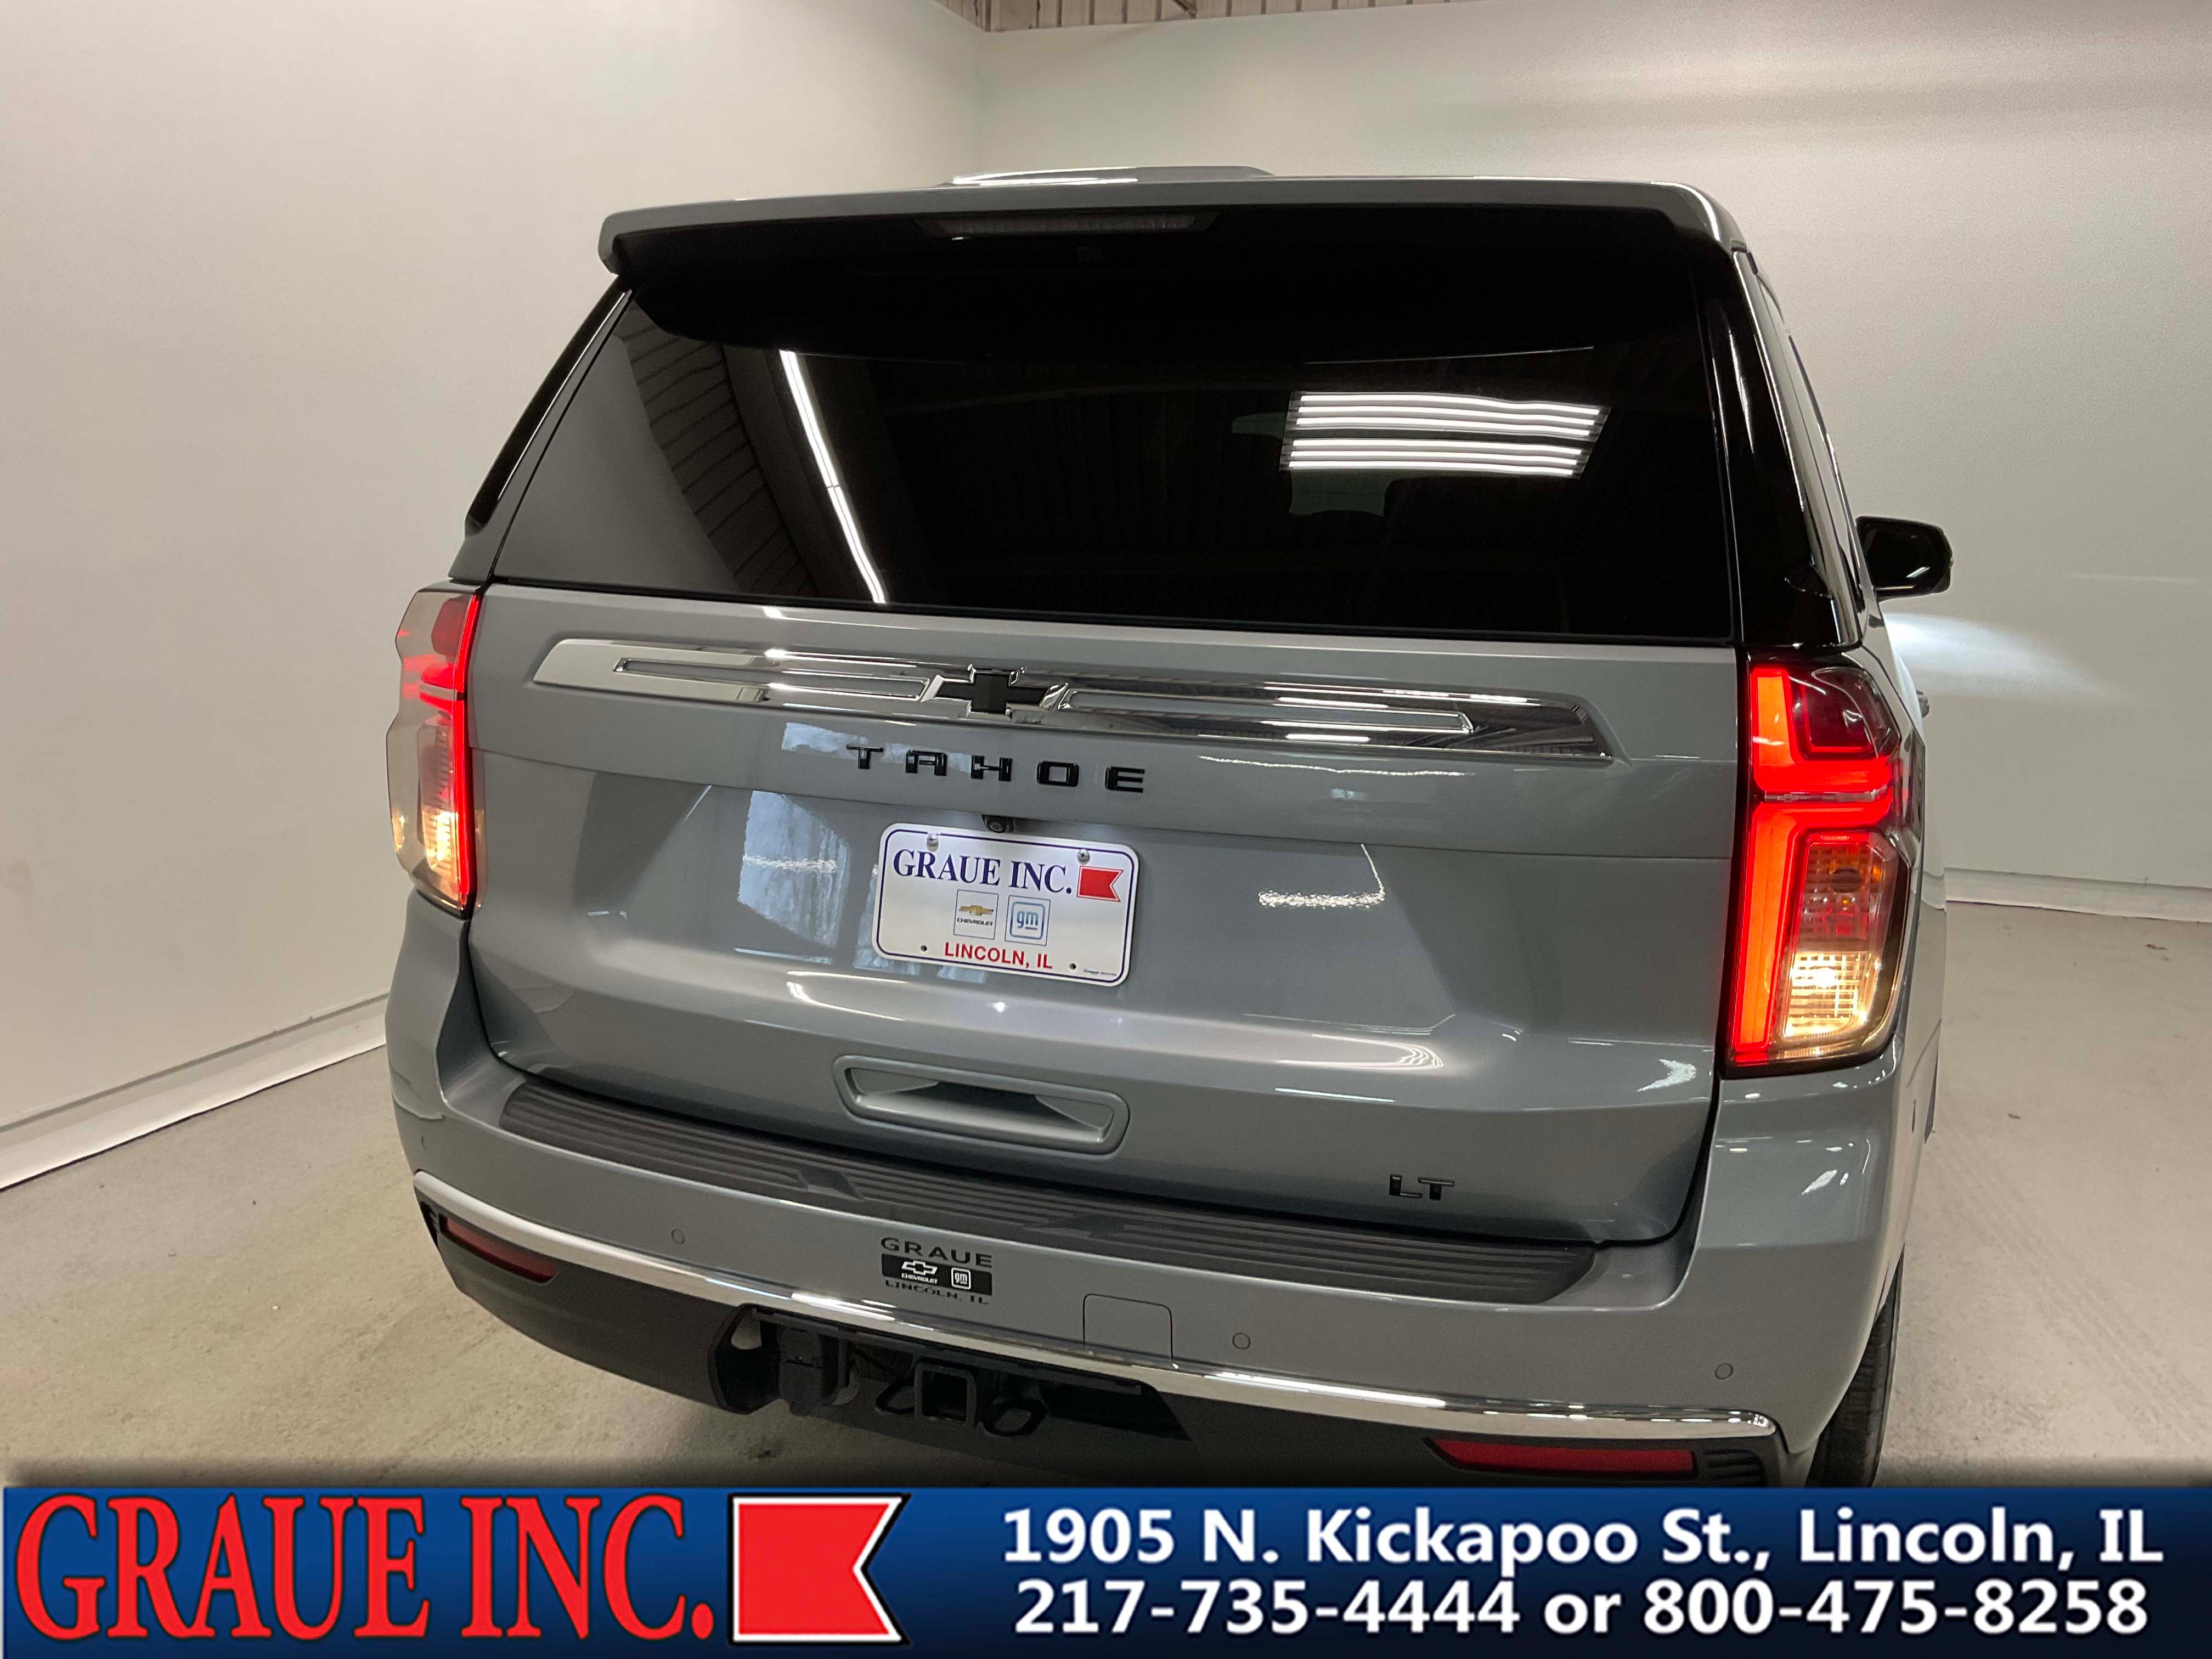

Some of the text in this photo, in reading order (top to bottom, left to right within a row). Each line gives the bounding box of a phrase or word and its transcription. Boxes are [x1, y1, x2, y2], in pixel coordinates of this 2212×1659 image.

[846, 744, 1145, 793] TAHOE
[893, 849, 1072, 894] GRAUE INC.
[956, 917, 994, 926] CHEVROLET
[1016, 909, 1039, 931] gm
[944, 942, 1053, 969] LINCOLN, IL
[1389, 1175, 1455, 1201] LT
[881, 1237, 992, 1268] GRAUE
[901, 1273, 938, 1284] CHEVROLET
[955, 1273, 968, 1284] gm
[885, 1280, 989, 1305] LINCOLN, IL
